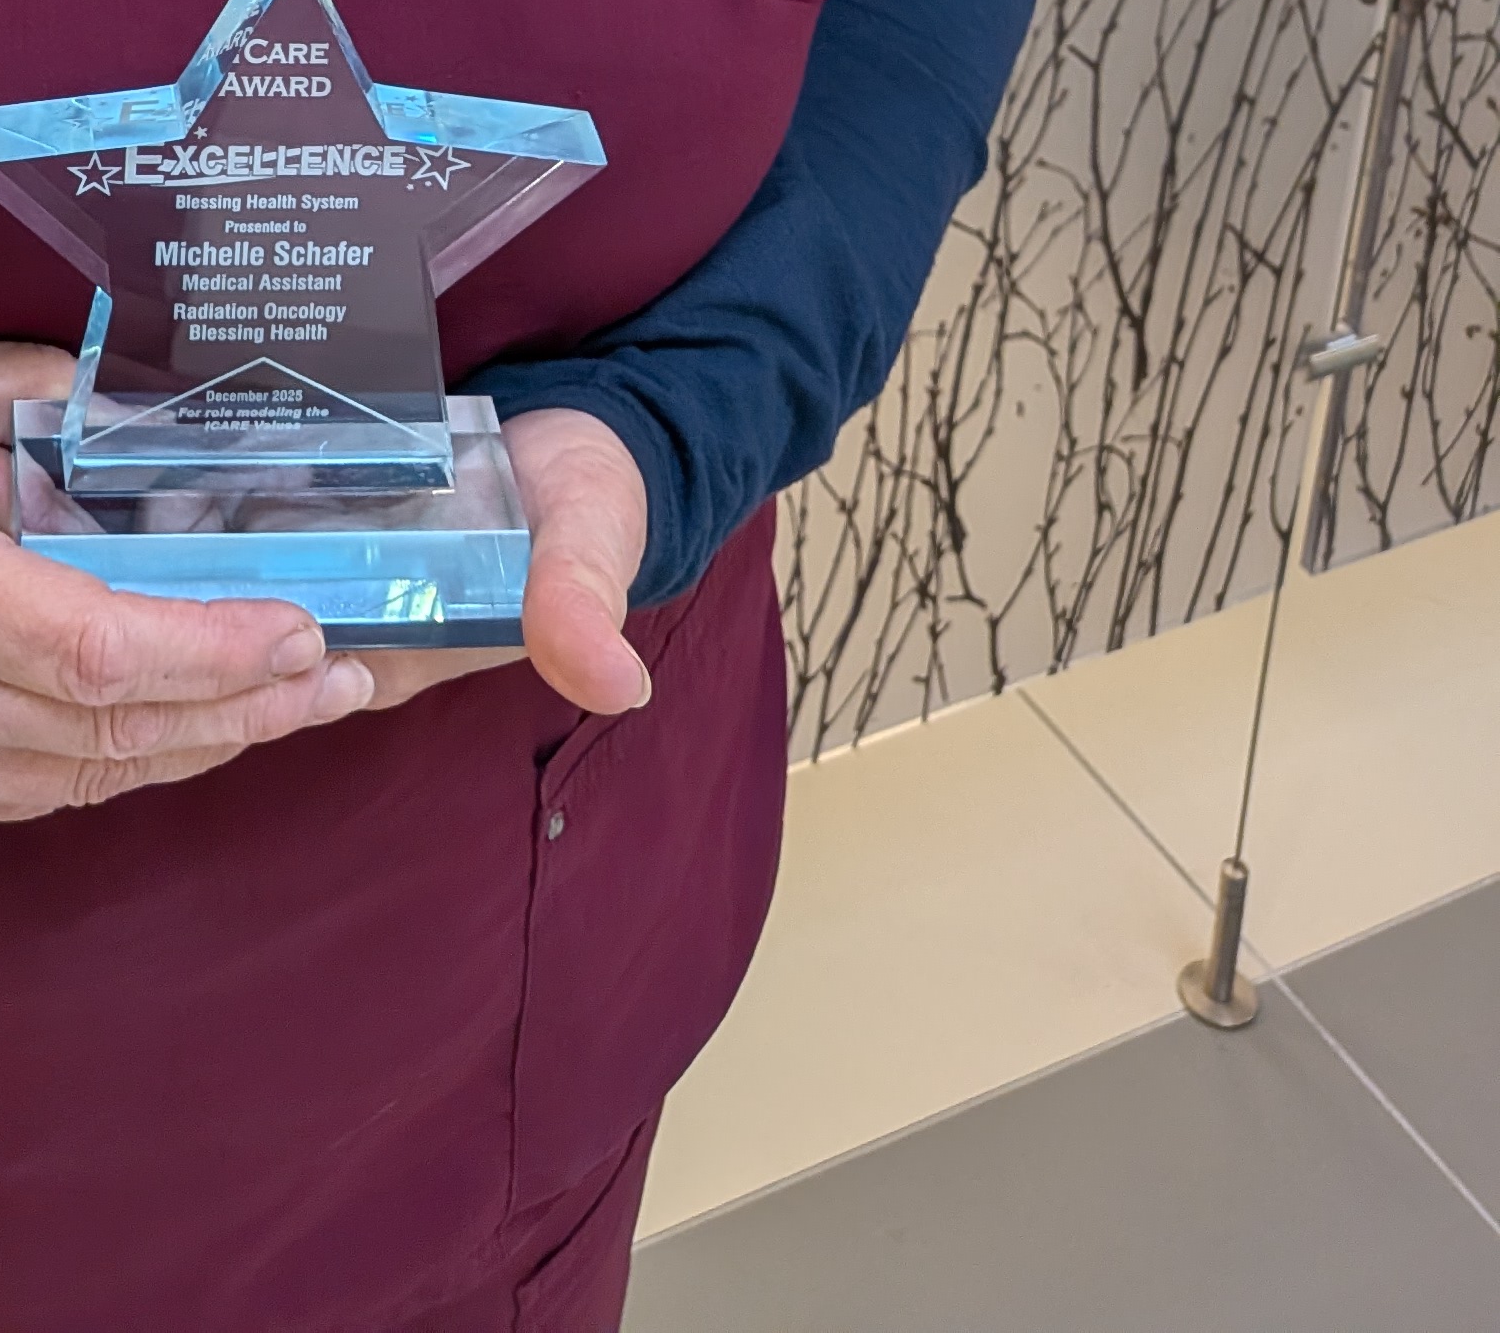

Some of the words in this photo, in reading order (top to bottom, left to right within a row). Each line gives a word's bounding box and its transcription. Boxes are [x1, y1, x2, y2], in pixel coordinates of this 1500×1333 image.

[217, 72, 332, 97] AWARD
[124, 142, 407, 185] EXCELLENCE
[175, 194, 242, 212] Blessing
[246, 194, 297, 210] Health
[301, 194, 359, 213] System
[225, 220, 290, 233] Presented
[293, 220, 307, 233] to
[155, 241, 265, 266] Michelle
[273, 240, 374, 266] Schafer
[182, 274, 254, 291] Medical
[258, 274, 342, 291] Assistant
[173, 302, 258, 320] Radiation
[264, 302, 347, 323] Oncology
[188, 324, 265, 344] Blessing
[270, 324, 328, 341] Health
[206, 390, 269, 402] December
[178, 407, 201, 418] For
[205, 407, 233, 418] role
[236, 407, 302, 419] modeling
[306, 406, 330, 417] the
[253, 421, 301, 432] Values
